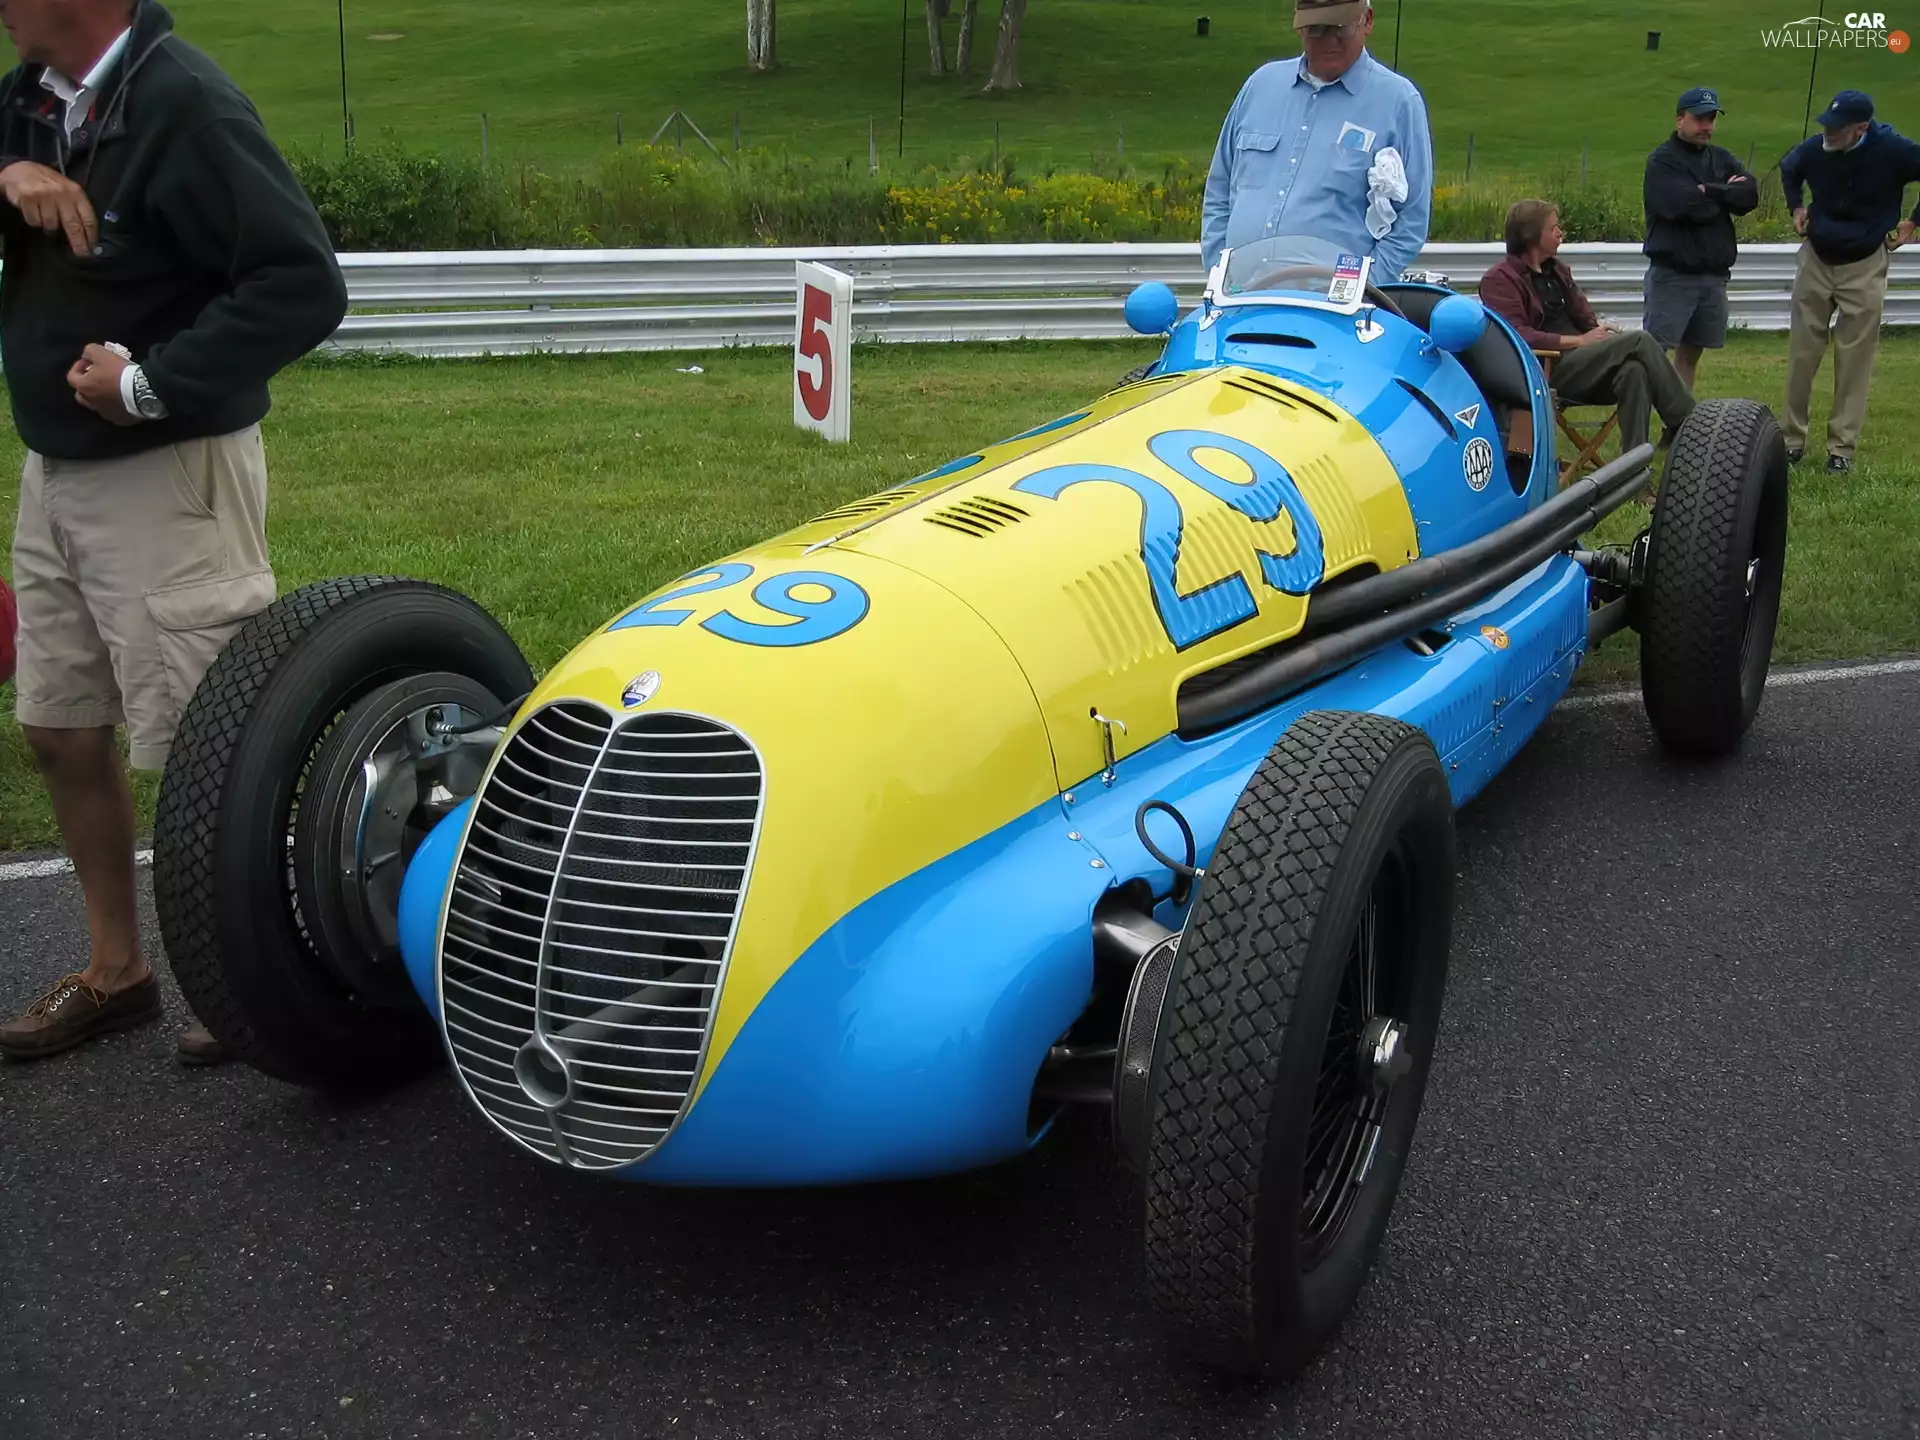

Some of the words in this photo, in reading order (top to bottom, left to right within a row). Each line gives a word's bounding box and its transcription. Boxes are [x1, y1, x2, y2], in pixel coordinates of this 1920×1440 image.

[797, 283, 832, 421] 5
[606, 562, 869, 648] 29
[1010, 428, 1326, 652] 29
